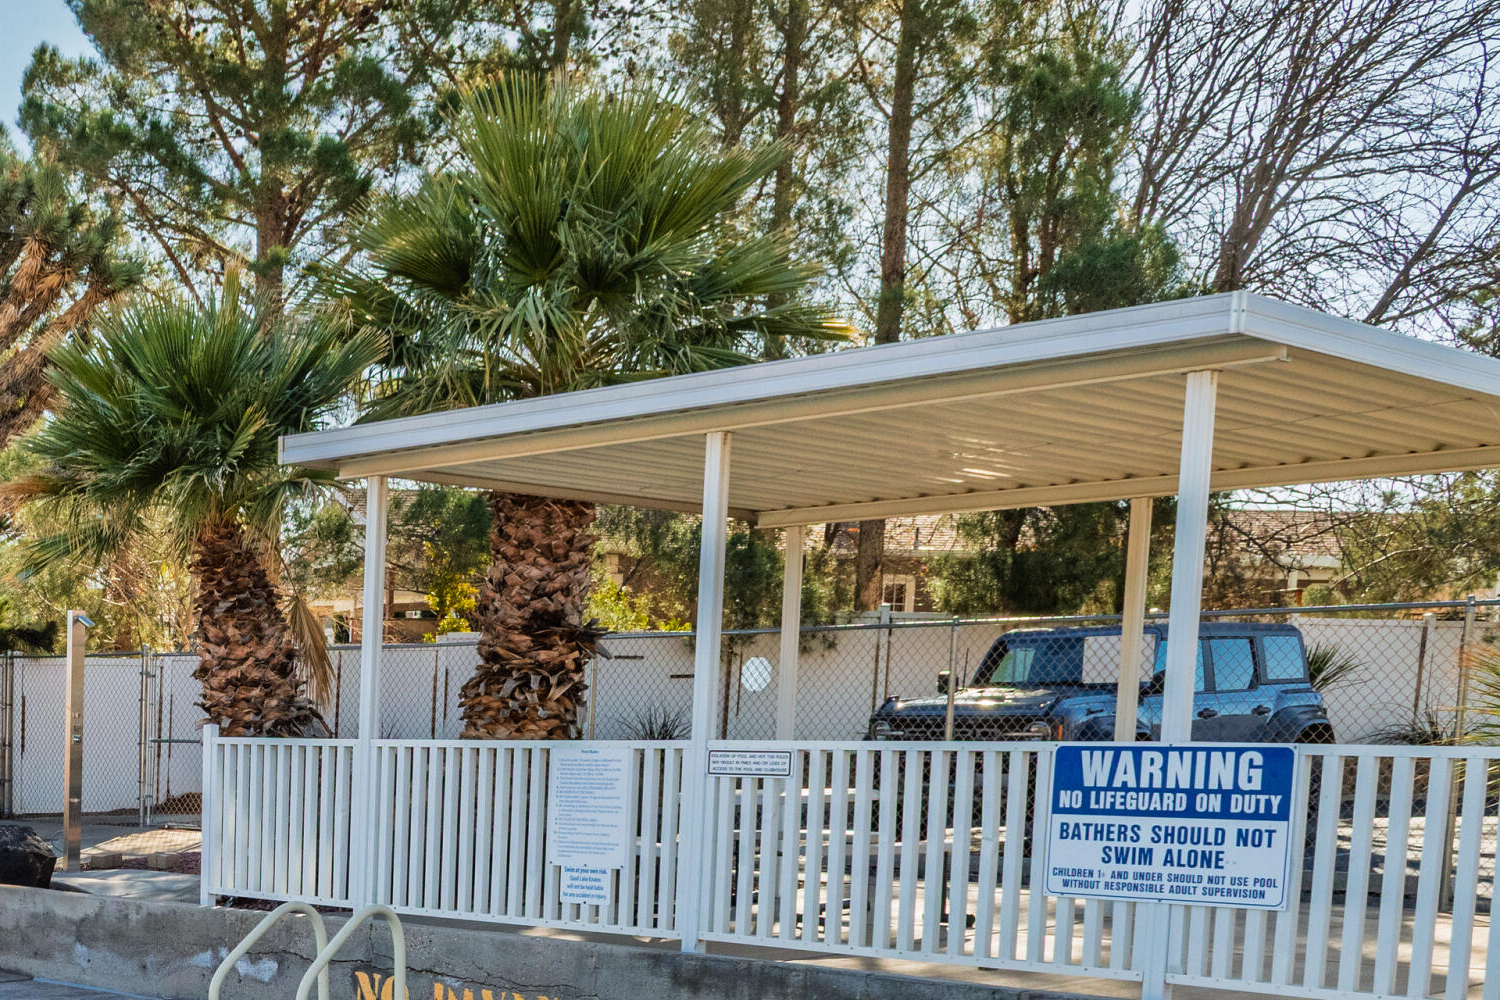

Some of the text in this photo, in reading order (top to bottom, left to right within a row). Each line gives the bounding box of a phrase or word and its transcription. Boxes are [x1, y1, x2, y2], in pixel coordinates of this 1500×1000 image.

[1081, 750, 1263, 791] WARNING
[1059, 790, 1282, 814] NO LIFEGUARD ON DUTY
[1060, 822, 1277, 848] BATHERS SHOULD NOT
[1101, 846, 1225, 869] SWIM ALONE
[1052, 867, 1094, 878] CHILDREN
[1110, 870, 1129, 880] AND
[1133, 871, 1163, 881] UNDER
[1167, 873, 1203, 884] SHOULD
[1207, 875, 1226, 885] NOT
[1230, 877, 1249, 886] USE
[1253, 878, 1278, 888] POOL
[1062, 879, 1266, 899] WITHOUT RESPONSIBLE ADULT SUPERVISION
